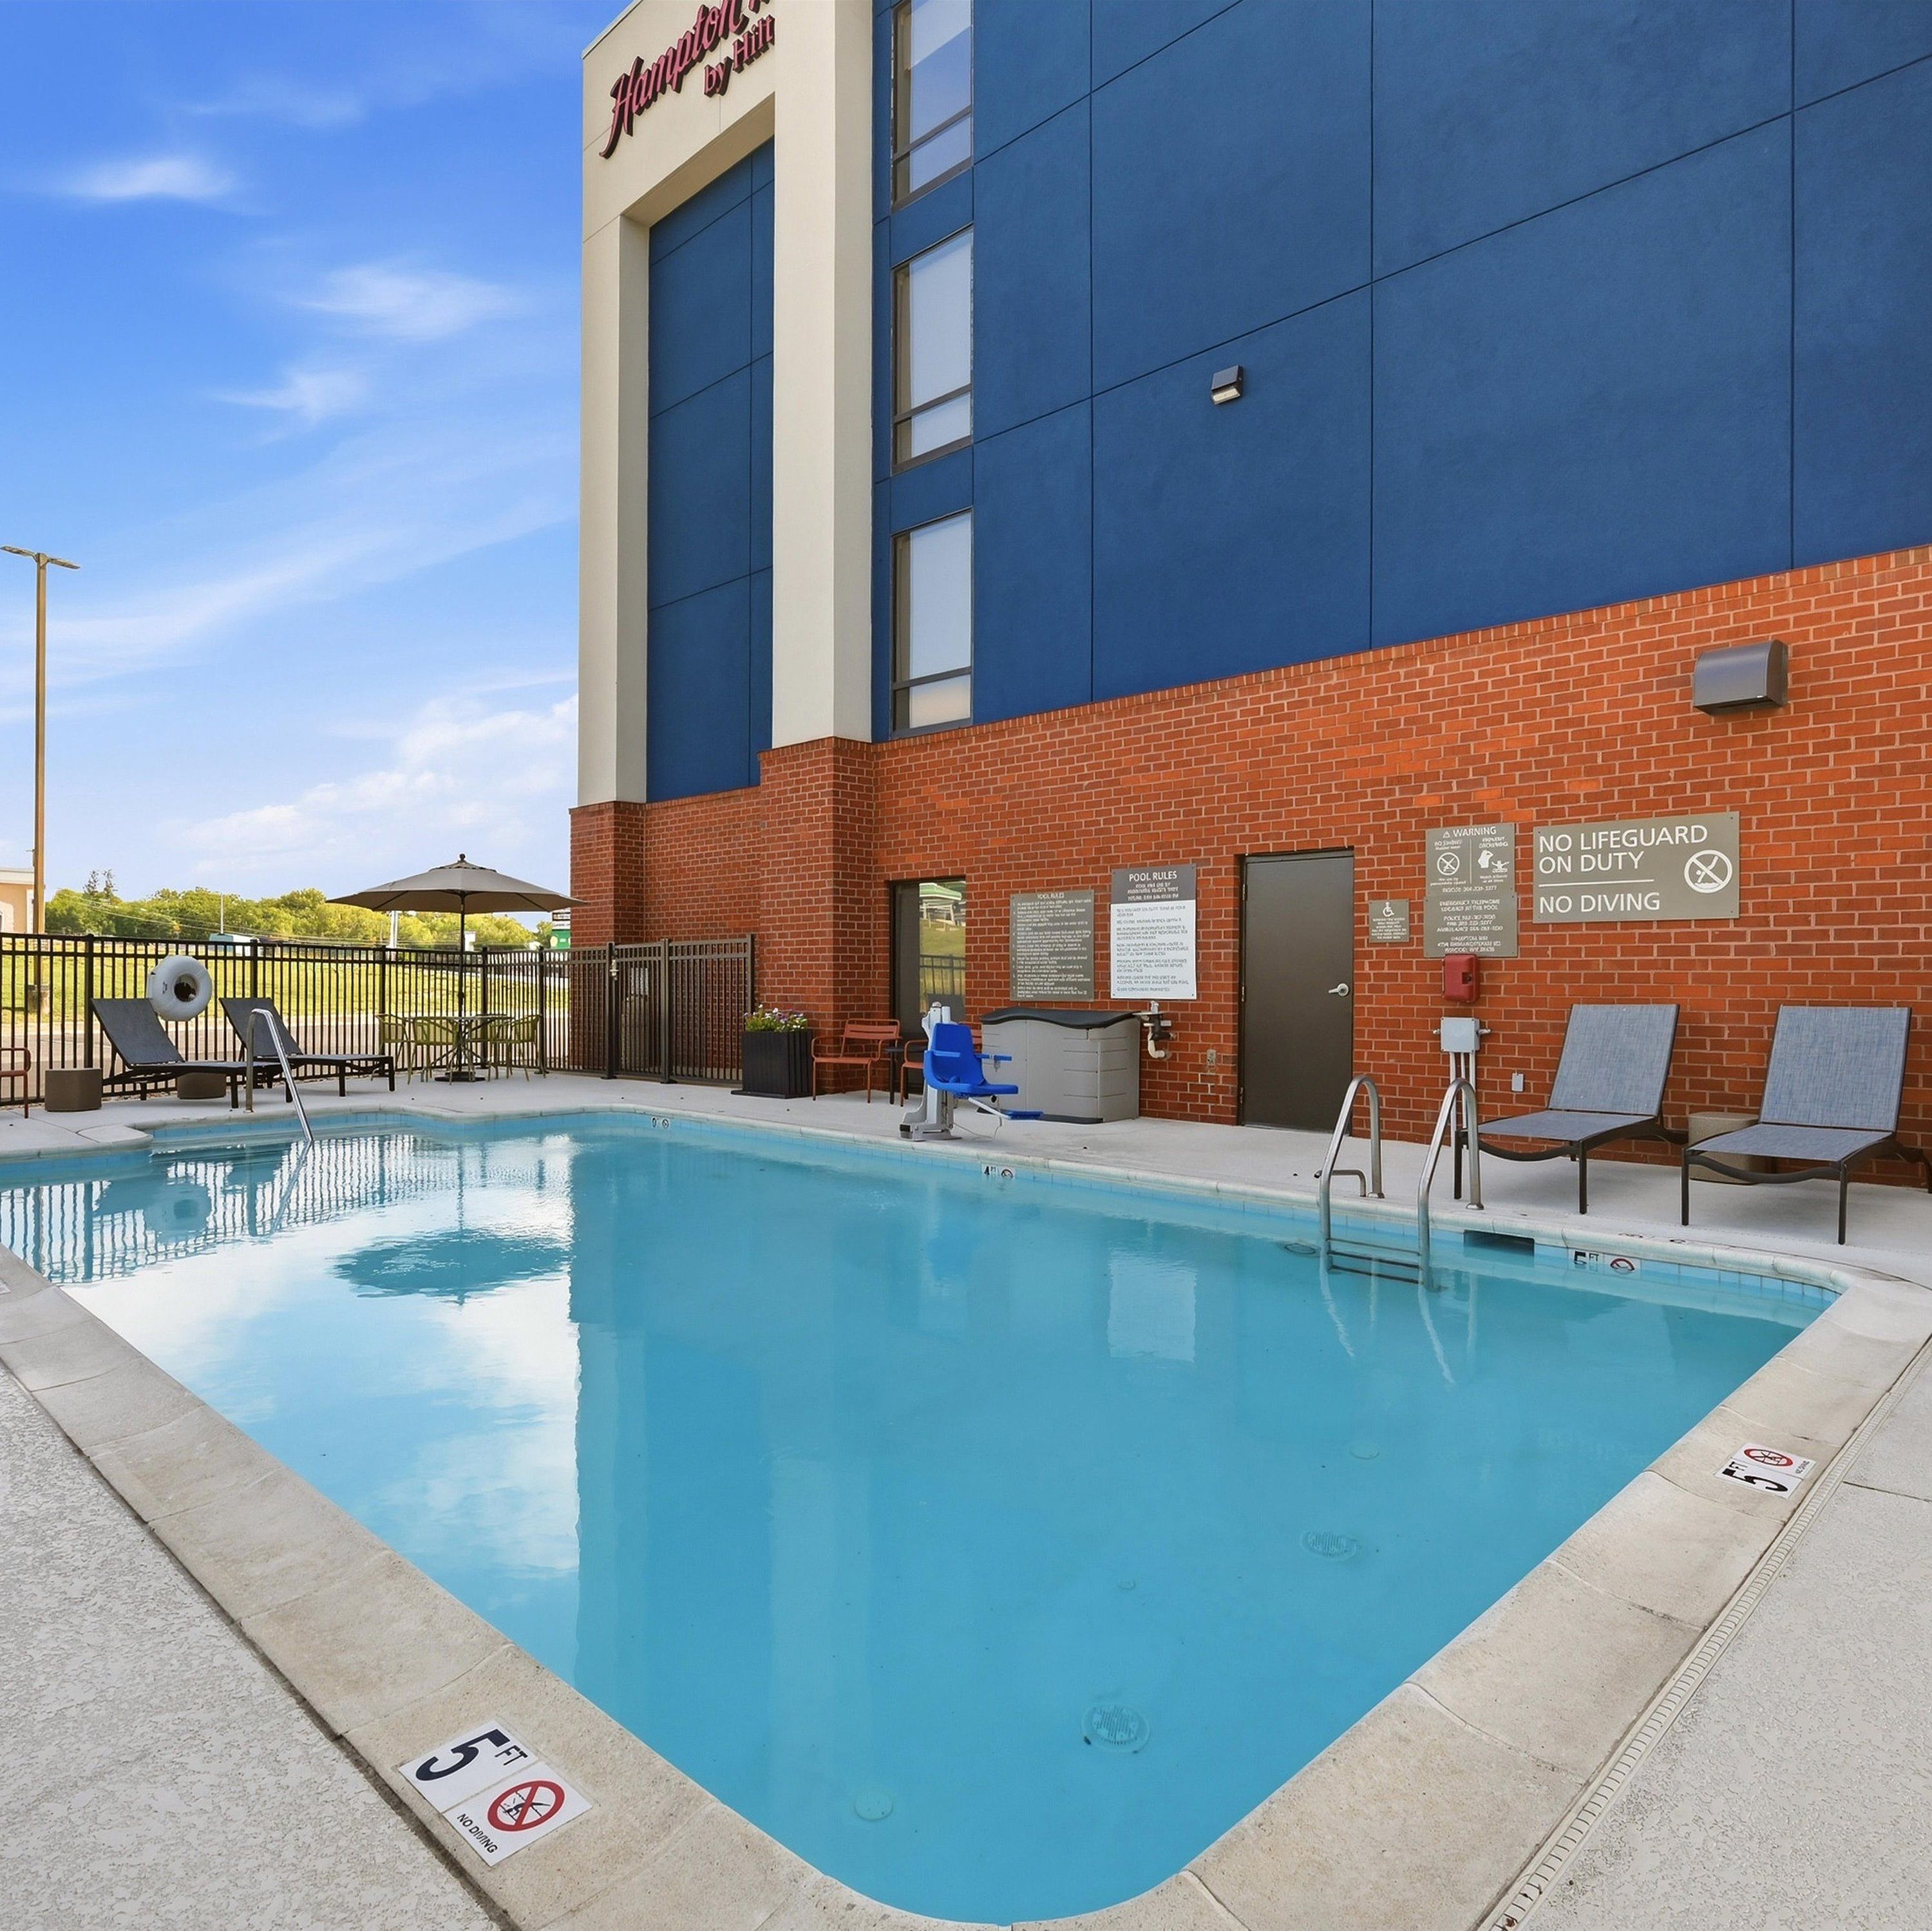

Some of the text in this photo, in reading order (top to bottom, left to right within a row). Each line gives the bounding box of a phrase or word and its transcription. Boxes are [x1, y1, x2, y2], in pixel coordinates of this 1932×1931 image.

[599, 0, 750, 159] Hampton
[704, 56, 734, 97] by
[1453, 826, 1497, 837] WARNING
[1539, 825, 1707, 852] NO LIFEGUARD
[1539, 851, 1644, 874] ON DUTY
[1129, 871, 1177, 881] POOL RULES
[1539, 892, 1660, 913] NO DIVING
[1574, 1251, 1587, 1265] 5
[1722, 1468, 1788, 1492] 5
[415, 1729, 528, 1781] 5 FT
[457, 1813, 498, 1854] NO DIVING
